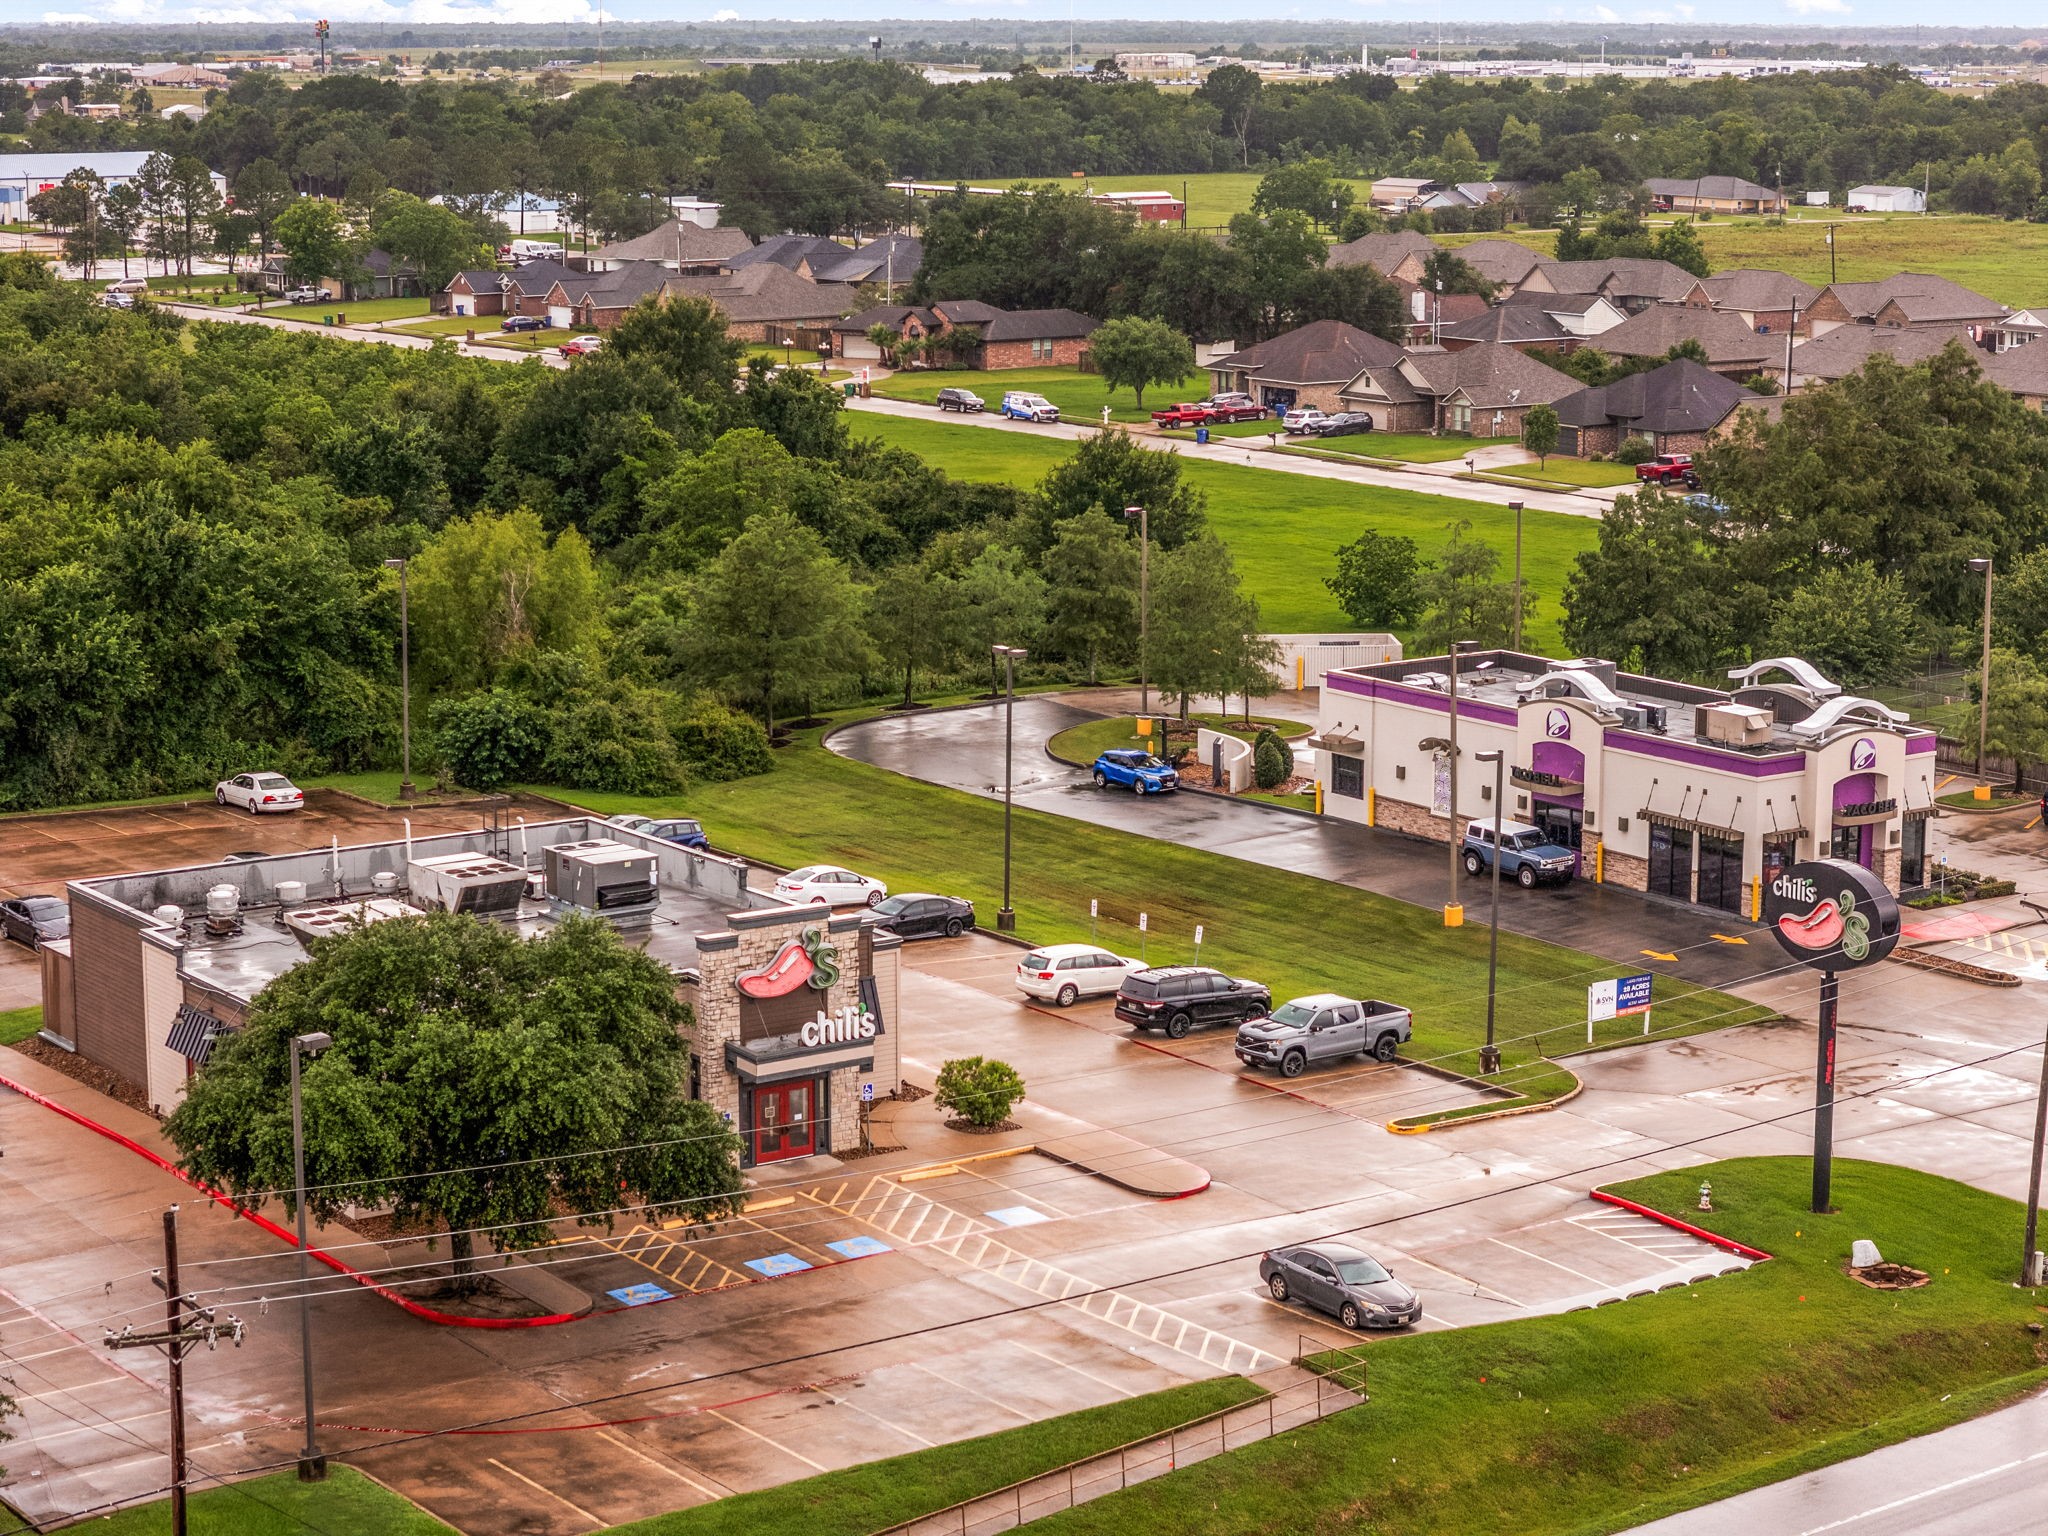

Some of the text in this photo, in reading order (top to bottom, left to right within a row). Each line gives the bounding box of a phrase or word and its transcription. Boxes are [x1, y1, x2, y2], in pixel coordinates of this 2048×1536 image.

[1510, 765, 1562, 787] TACO BELL
[1844, 802, 1876, 817] TACO
[1773, 875, 1817, 903] chili's
[1619, 990, 1649, 1000] AVAILABLE
[1631, 982, 1650, 991] ACRES
[801, 1002, 876, 1047] chili's
